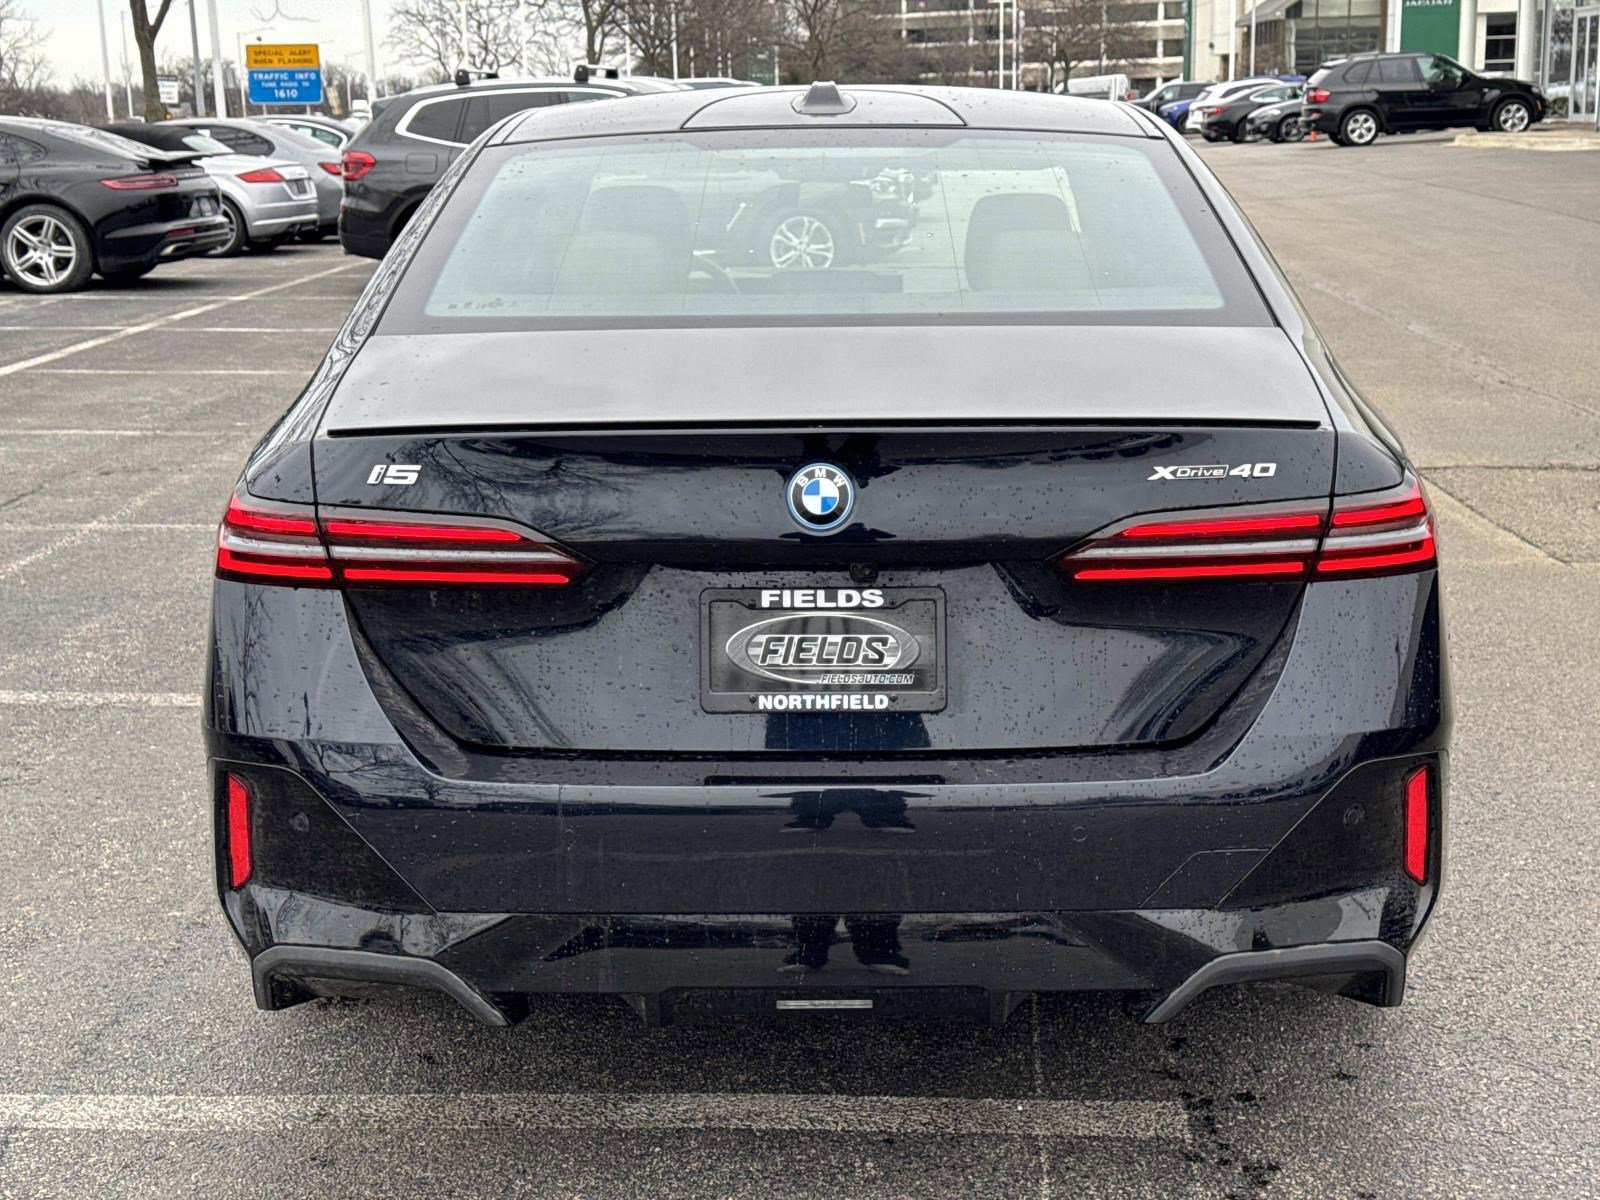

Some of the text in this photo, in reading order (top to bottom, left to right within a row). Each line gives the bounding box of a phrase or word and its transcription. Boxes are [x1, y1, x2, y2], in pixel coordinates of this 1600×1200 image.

[253, 72, 316, 80] TRAFFIC INFO
[274, 89, 298, 98] 1610
[796, 467, 847, 488] BMW
[761, 589, 884, 608] FIELDS
[757, 634, 891, 666] FIELDS
[758, 694, 889, 710] NORTHFIELD
